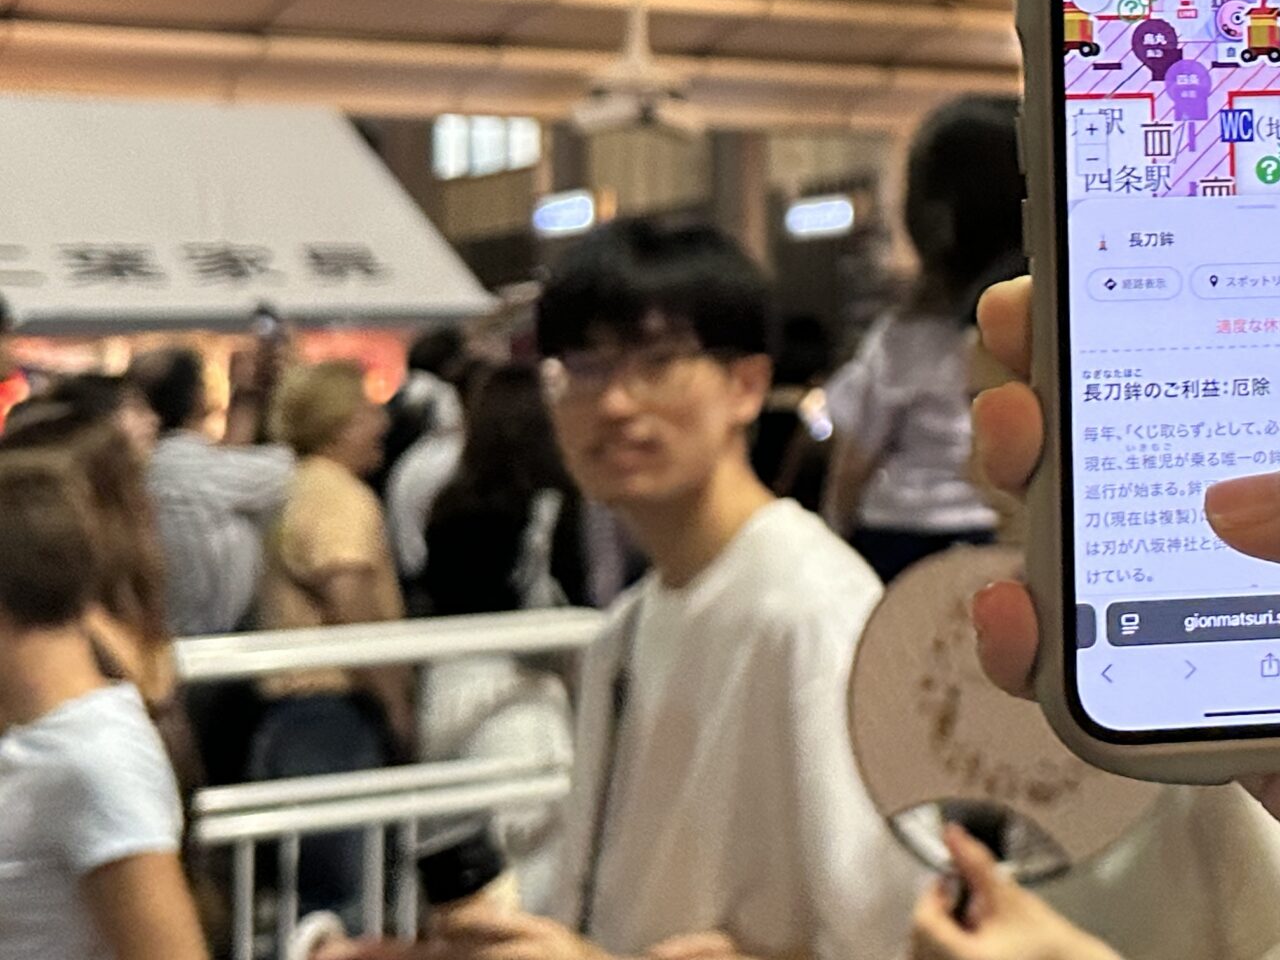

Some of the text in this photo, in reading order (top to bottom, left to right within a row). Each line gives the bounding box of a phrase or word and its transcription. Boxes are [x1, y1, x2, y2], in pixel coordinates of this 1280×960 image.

[1222, 112, 1252, 139] WC
[1085, 165, 1171, 193] 四条駅
[1129, 232, 1175, 247] 長刀鉾
[1083, 368, 1142, 379] なぎなたほこ
[1083, 376, 1271, 402] 長刀鉾のご利益：厄除
[1085, 479, 1218, 500] 巡行が始まる。鉾
[1086, 568, 1154, 584] けている。
